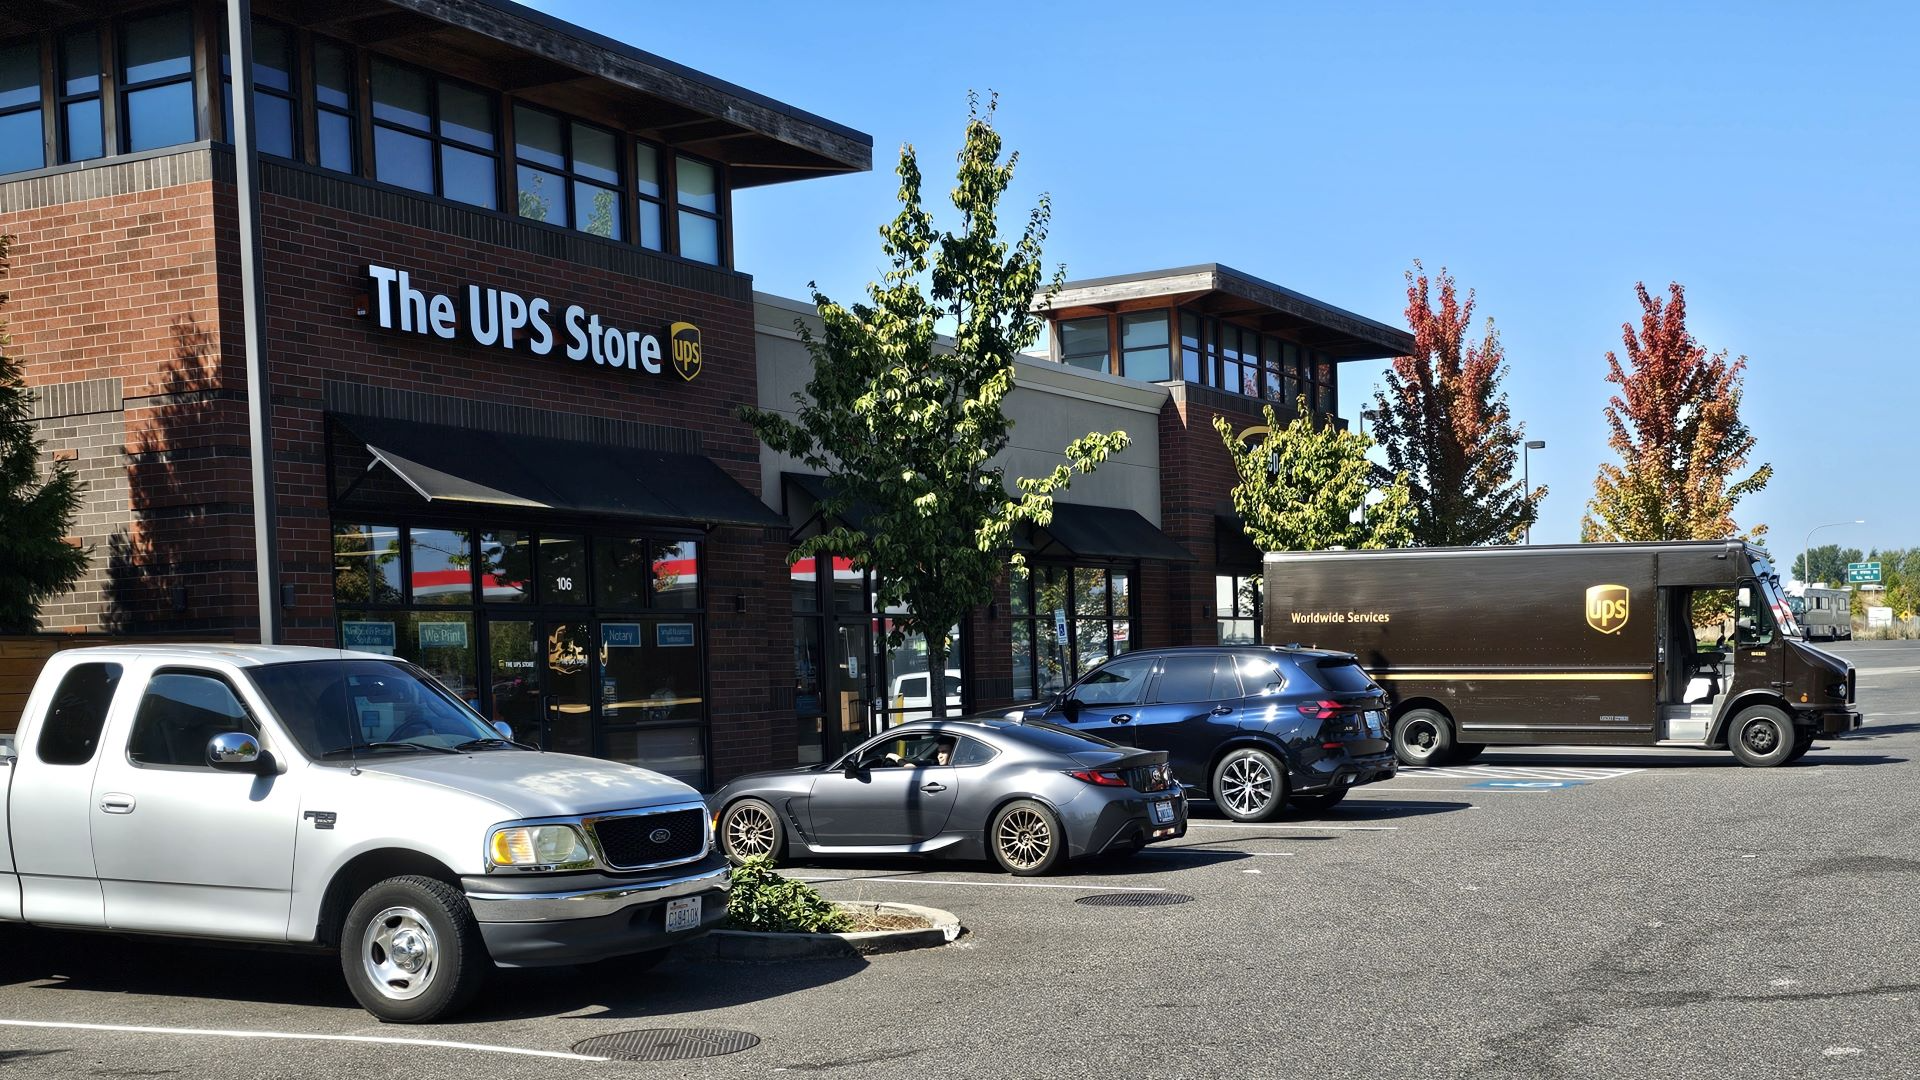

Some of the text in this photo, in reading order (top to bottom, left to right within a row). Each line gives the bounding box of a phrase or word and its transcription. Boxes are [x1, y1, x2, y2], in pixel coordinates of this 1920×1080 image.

[368, 265, 661, 374] The UPS Store
[674, 337, 700, 371] ups
[557, 577, 572, 591] 106
[1291, 612, 1390, 623] Worldwide Services
[1589, 599, 1626, 627] ups
[425, 629, 461, 642] We Print
[609, 629, 633, 644] Notary
